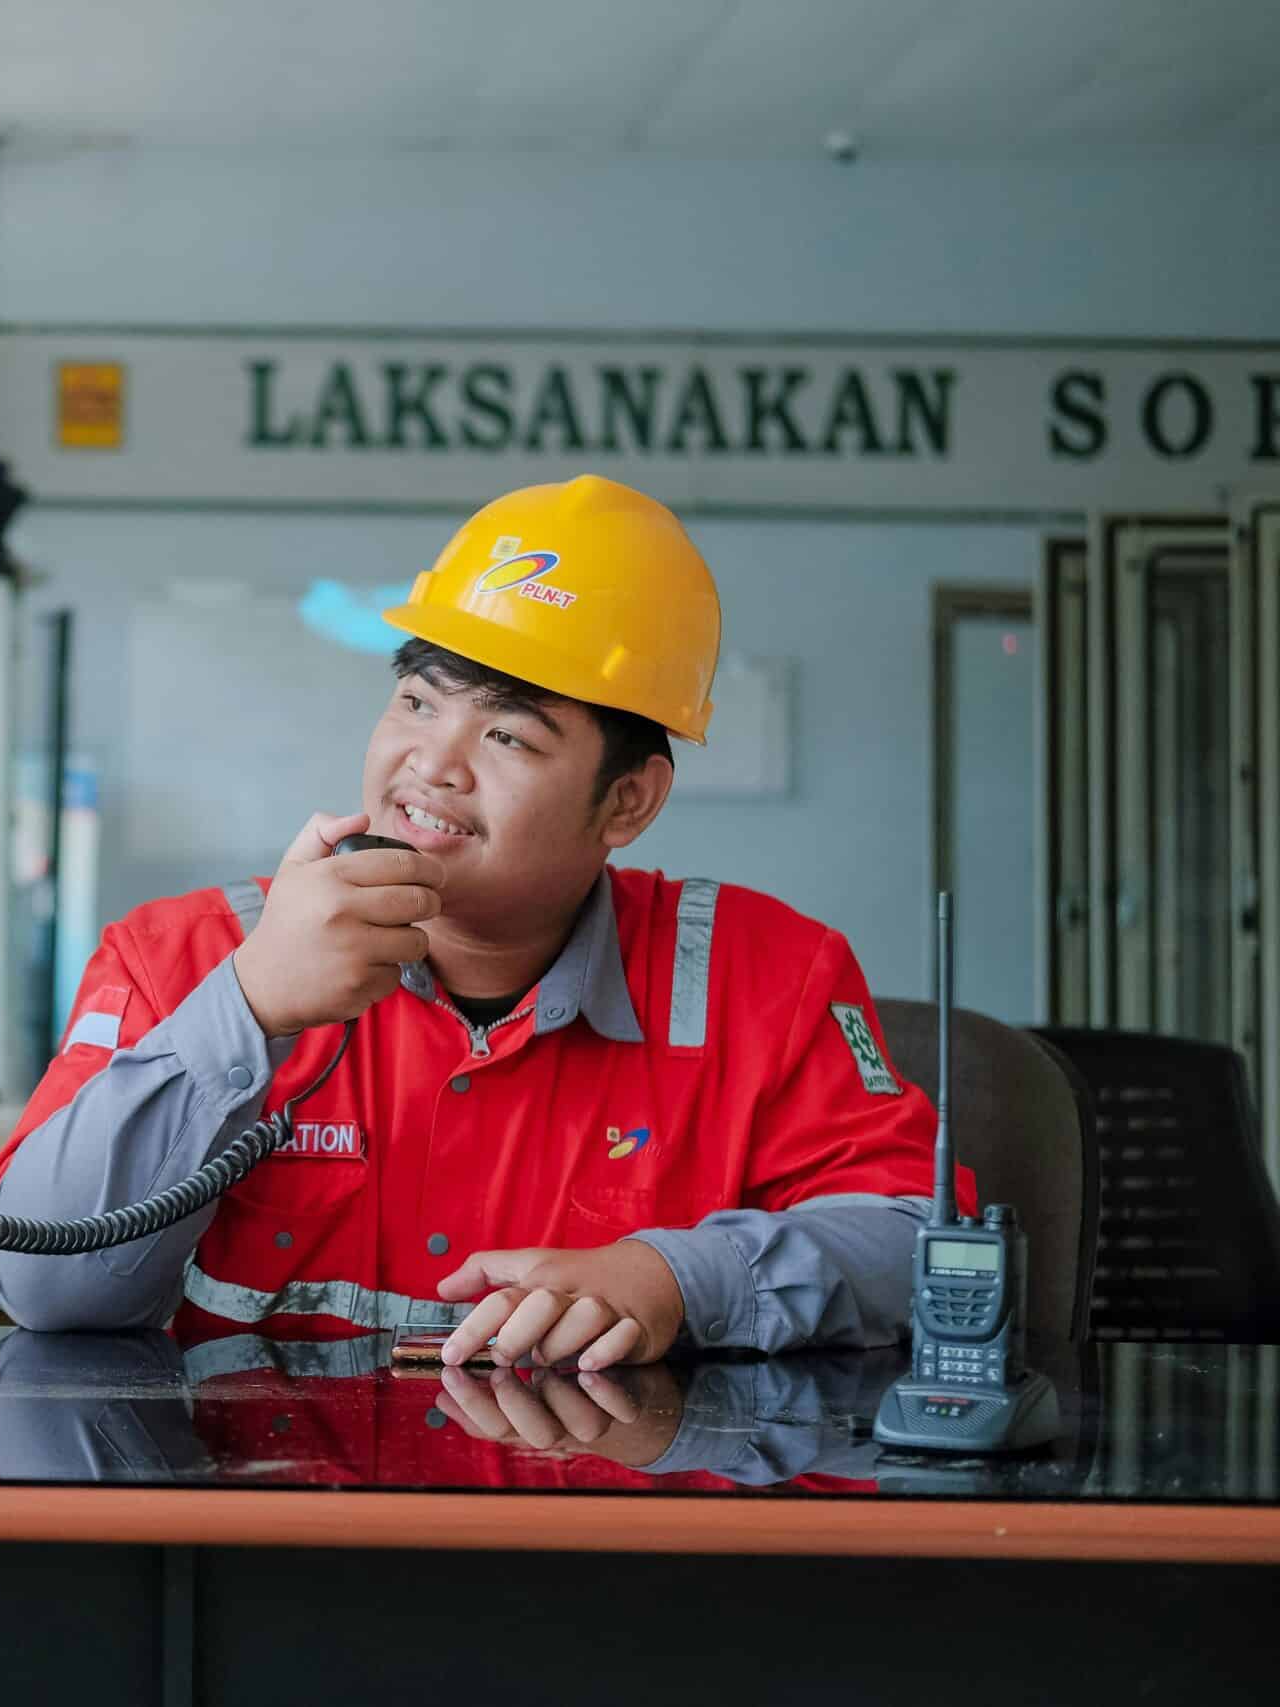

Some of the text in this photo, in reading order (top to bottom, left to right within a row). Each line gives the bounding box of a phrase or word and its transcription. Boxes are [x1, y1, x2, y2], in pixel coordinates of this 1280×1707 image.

[246, 360, 956, 456] LAKSANAKAN
[521, 582, 575, 608] PLN-T
[274, 1123, 355, 1152] ATION
